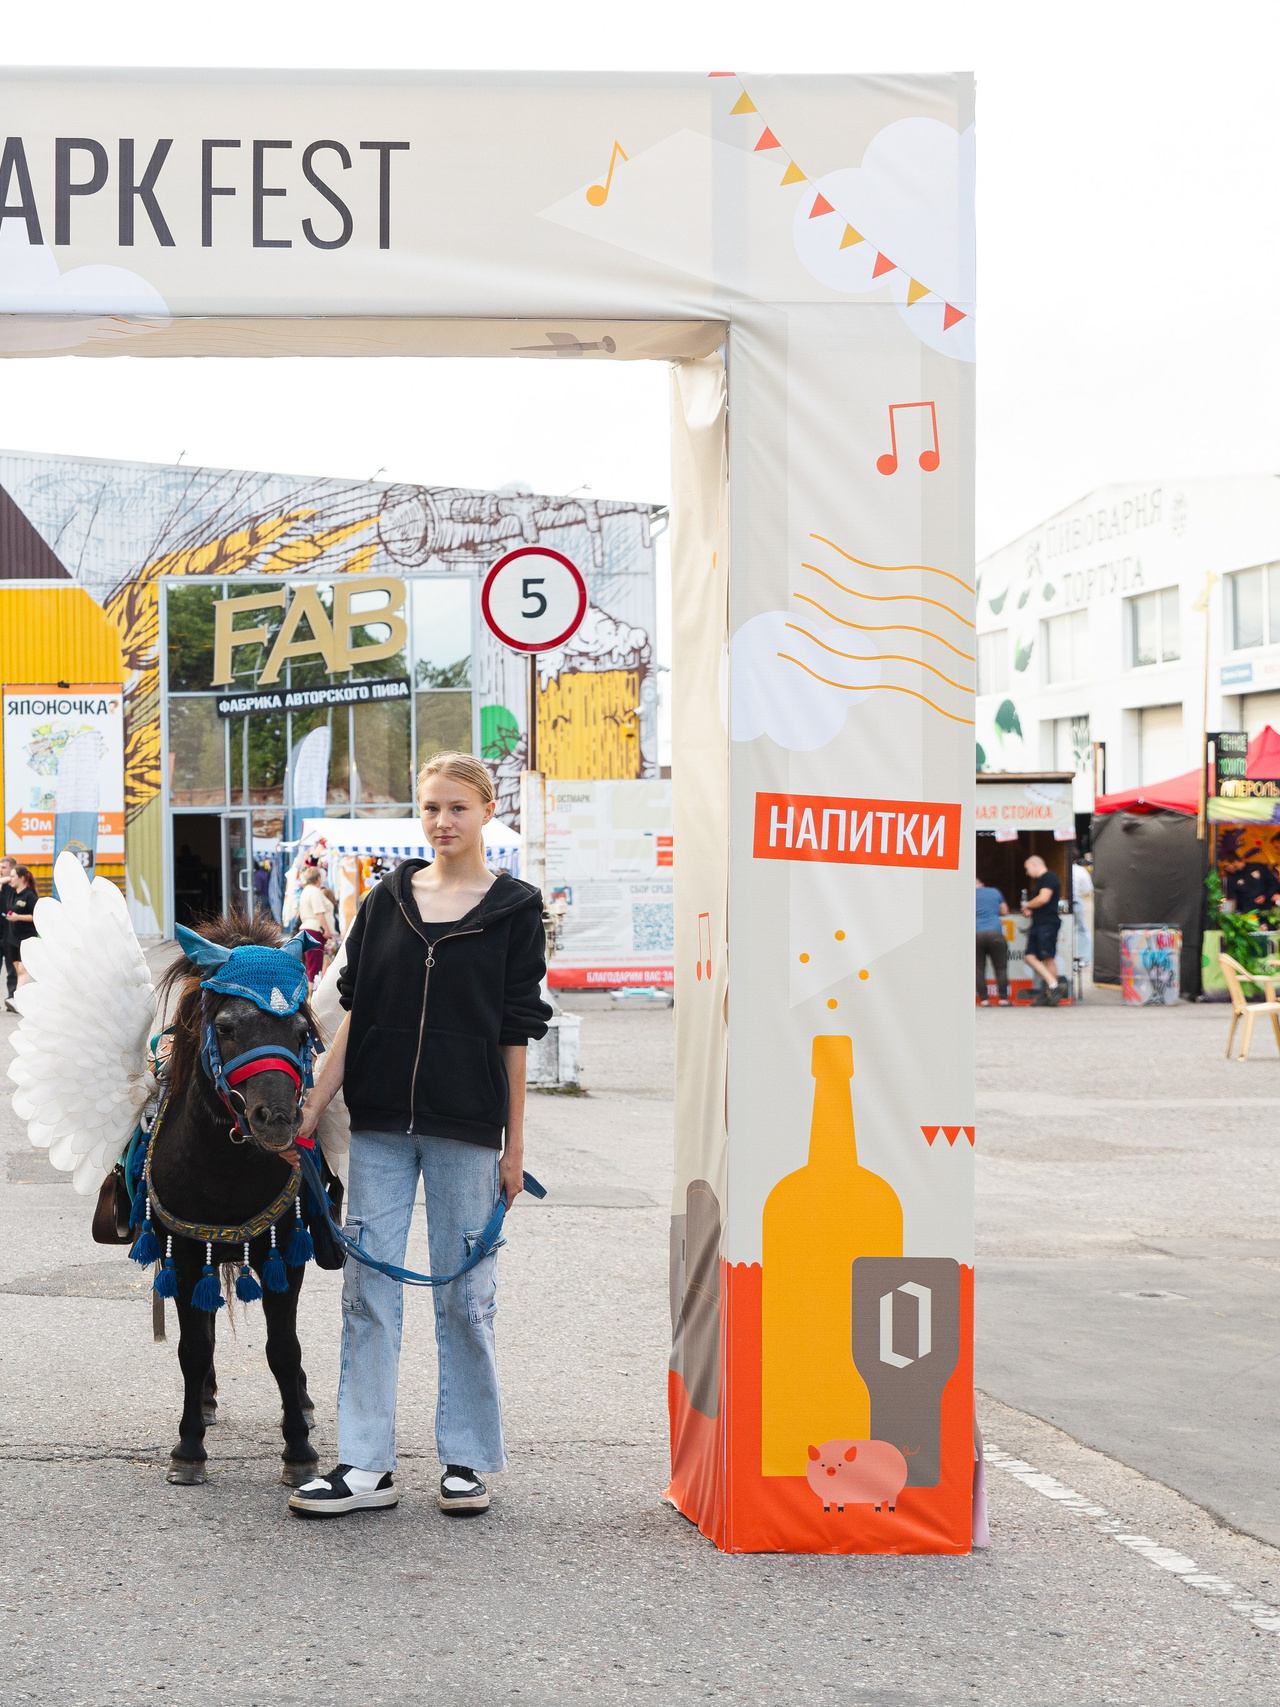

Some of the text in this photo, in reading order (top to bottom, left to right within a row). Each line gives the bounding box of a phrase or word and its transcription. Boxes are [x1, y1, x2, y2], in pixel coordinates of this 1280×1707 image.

[201, 139, 411, 251] FEST
[1047, 487, 1163, 559] ПИВОВАРНЯ
[521, 578, 547, 619] 5
[1062, 556, 1145, 606] ТОРТУГА
[210, 576, 408, 687] FAB
[7, 699, 108, 715] ЯПОНОЧКА
[218, 682, 409, 714] ФАБРИКА АВТОРСКОГО ПИВА
[557, 795, 590, 803] ОСТМАРК
[1001, 803, 1053, 819] СТОЙКА
[21, 817, 52, 831] 30м
[769, 805, 946, 857] НАПИТКИ
[586, 971, 643, 983] БЛАГОДАРИМ
[645, 971, 661, 982] ВАС
